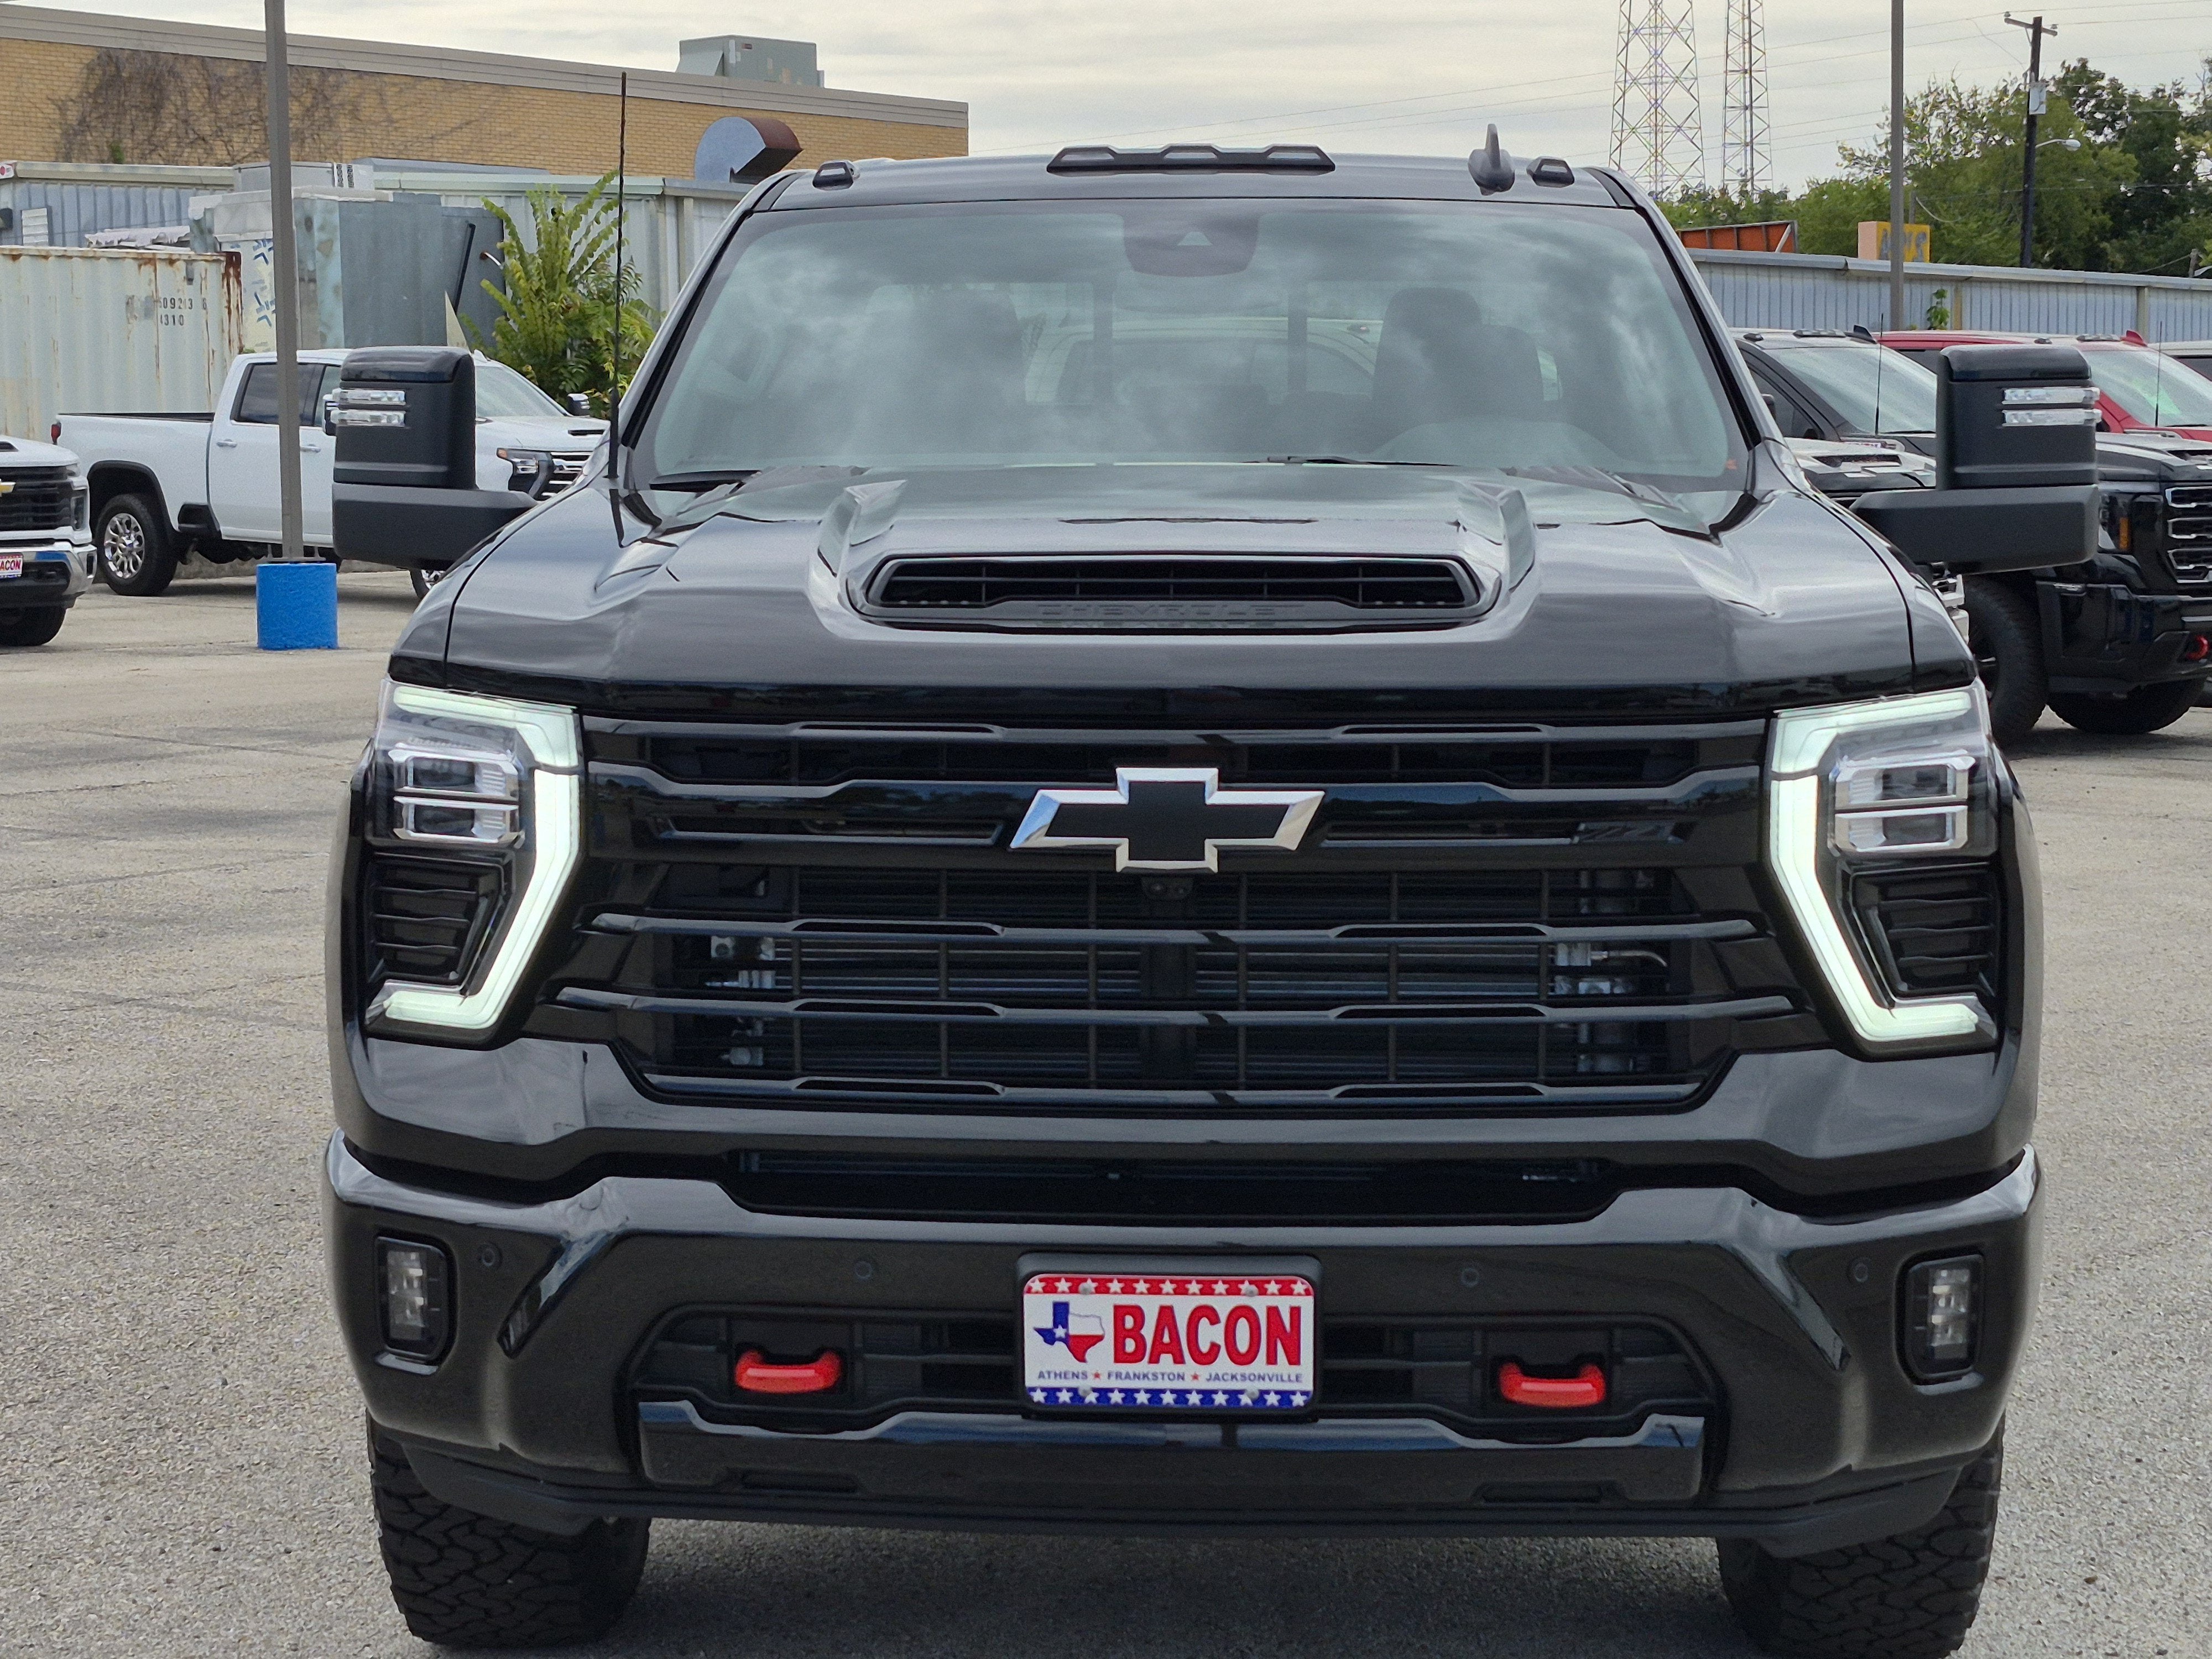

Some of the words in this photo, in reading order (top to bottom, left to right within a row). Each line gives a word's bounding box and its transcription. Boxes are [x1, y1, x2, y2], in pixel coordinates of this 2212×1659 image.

[1113, 1304, 1301, 1366] BACON
[1037, 1370, 1088, 1380] ATHENS
[1107, 1370, 1185, 1381] FRANKSTON
[1206, 1372, 1303, 1383] JACKSONVILLE
